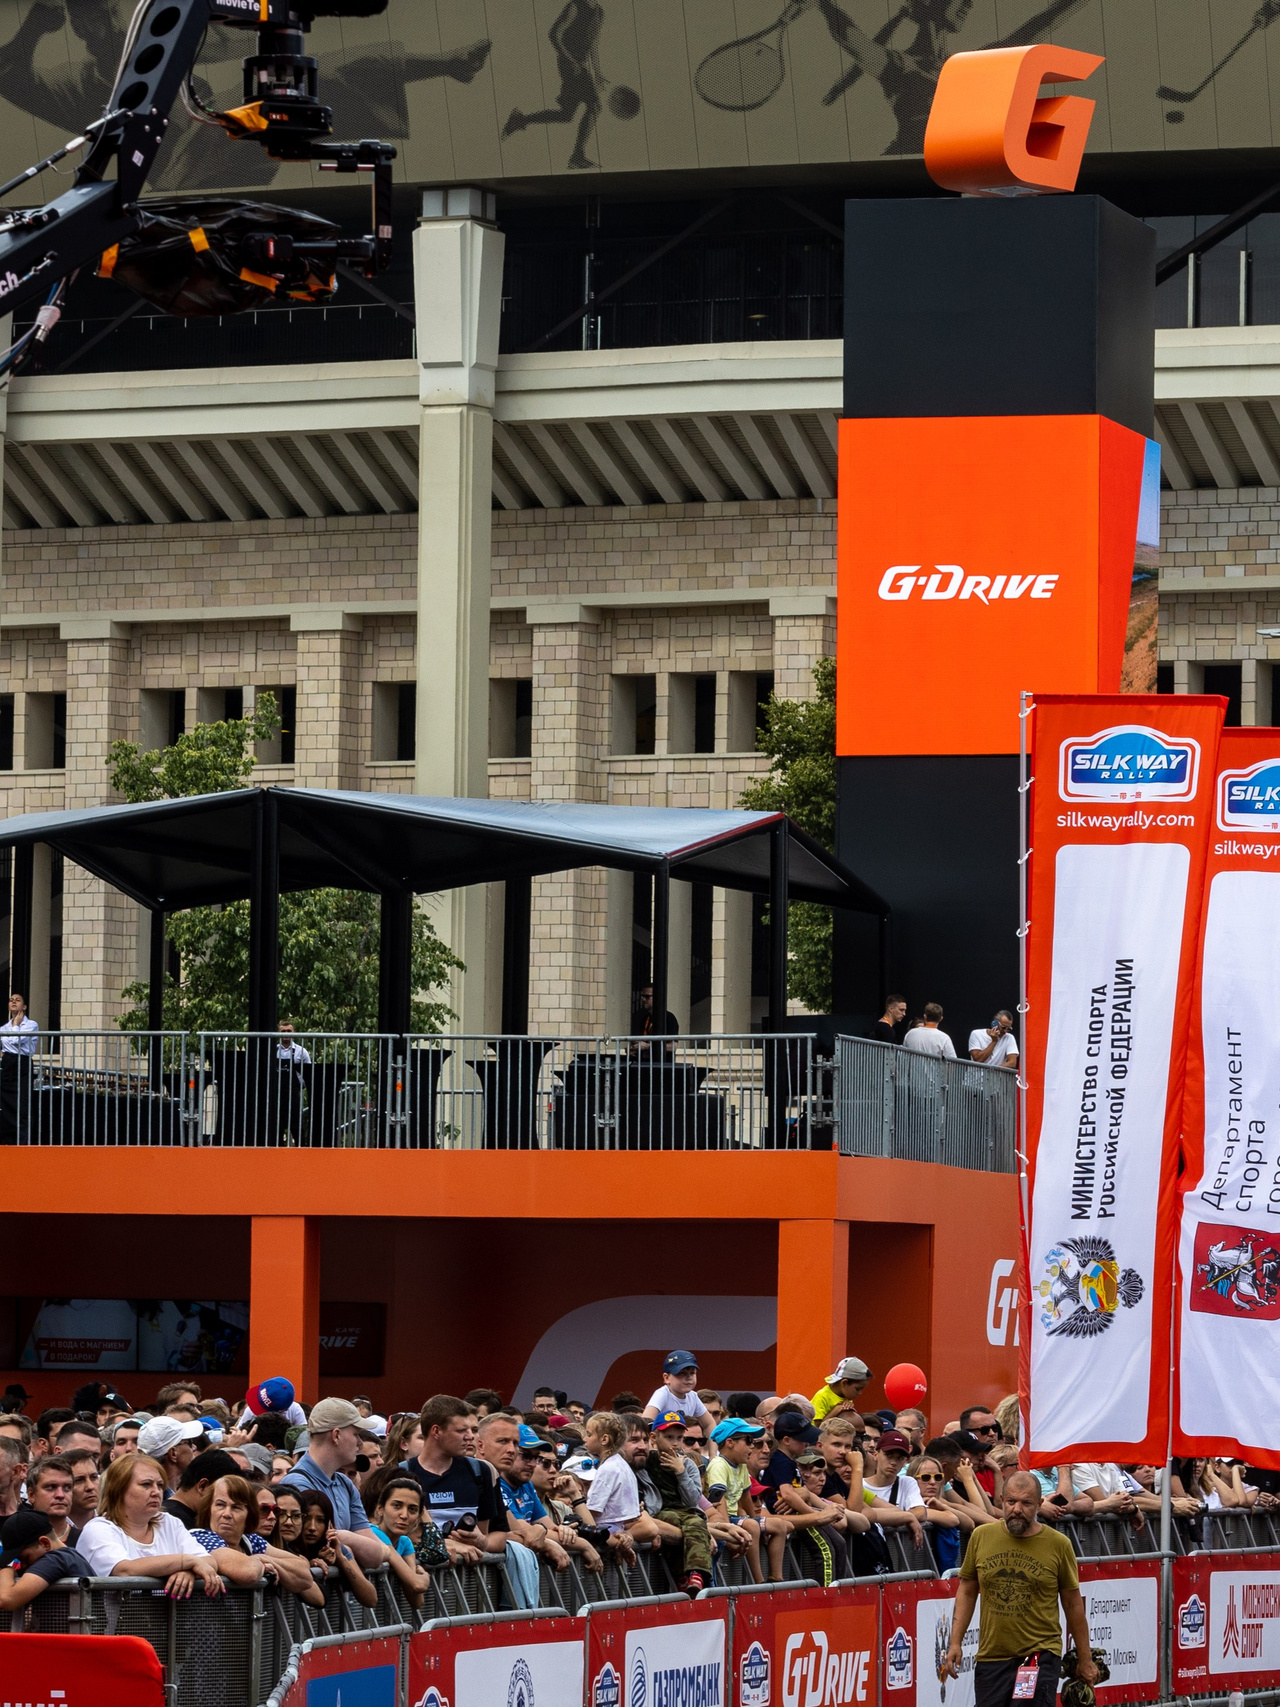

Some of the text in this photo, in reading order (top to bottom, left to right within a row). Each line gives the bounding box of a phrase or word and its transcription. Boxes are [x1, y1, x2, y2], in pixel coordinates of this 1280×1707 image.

[1073, 754, 1187, 770] SILK WAY
[1101, 771, 1157, 779] RALLY
[1057, 811, 1195, 831] silkwayrally.com
[1110, 958, 1136, 1080] ФЕДЕРАЦИИ
[1071, 983, 1108, 1220] МИНИСТЕРСТВО СПОРТА
[1200, 1027, 1243, 1211] Департамент
[1235, 1119, 1268, 1212] спорта
[58, 1341, 78, 1349] ВОДА
[87, 1341, 125, 1349] МАГНИЕМ
[57, 1353, 96, 1361] ПОДАРОК!
[982, 1558, 1045, 1577] NAVAL SUPPLY
[986, 1552, 1045, 1570] NORTH AMERICAN
[1090, 1597, 1131, 1619] Департамент
[1090, 1626, 1112, 1646] спорта
[1241, 1623, 1264, 1658] СПОРТ
[1113, 1648, 1138, 1667] Москвы
[653, 1661, 721, 1707] ГАЗПРОМБАНК
